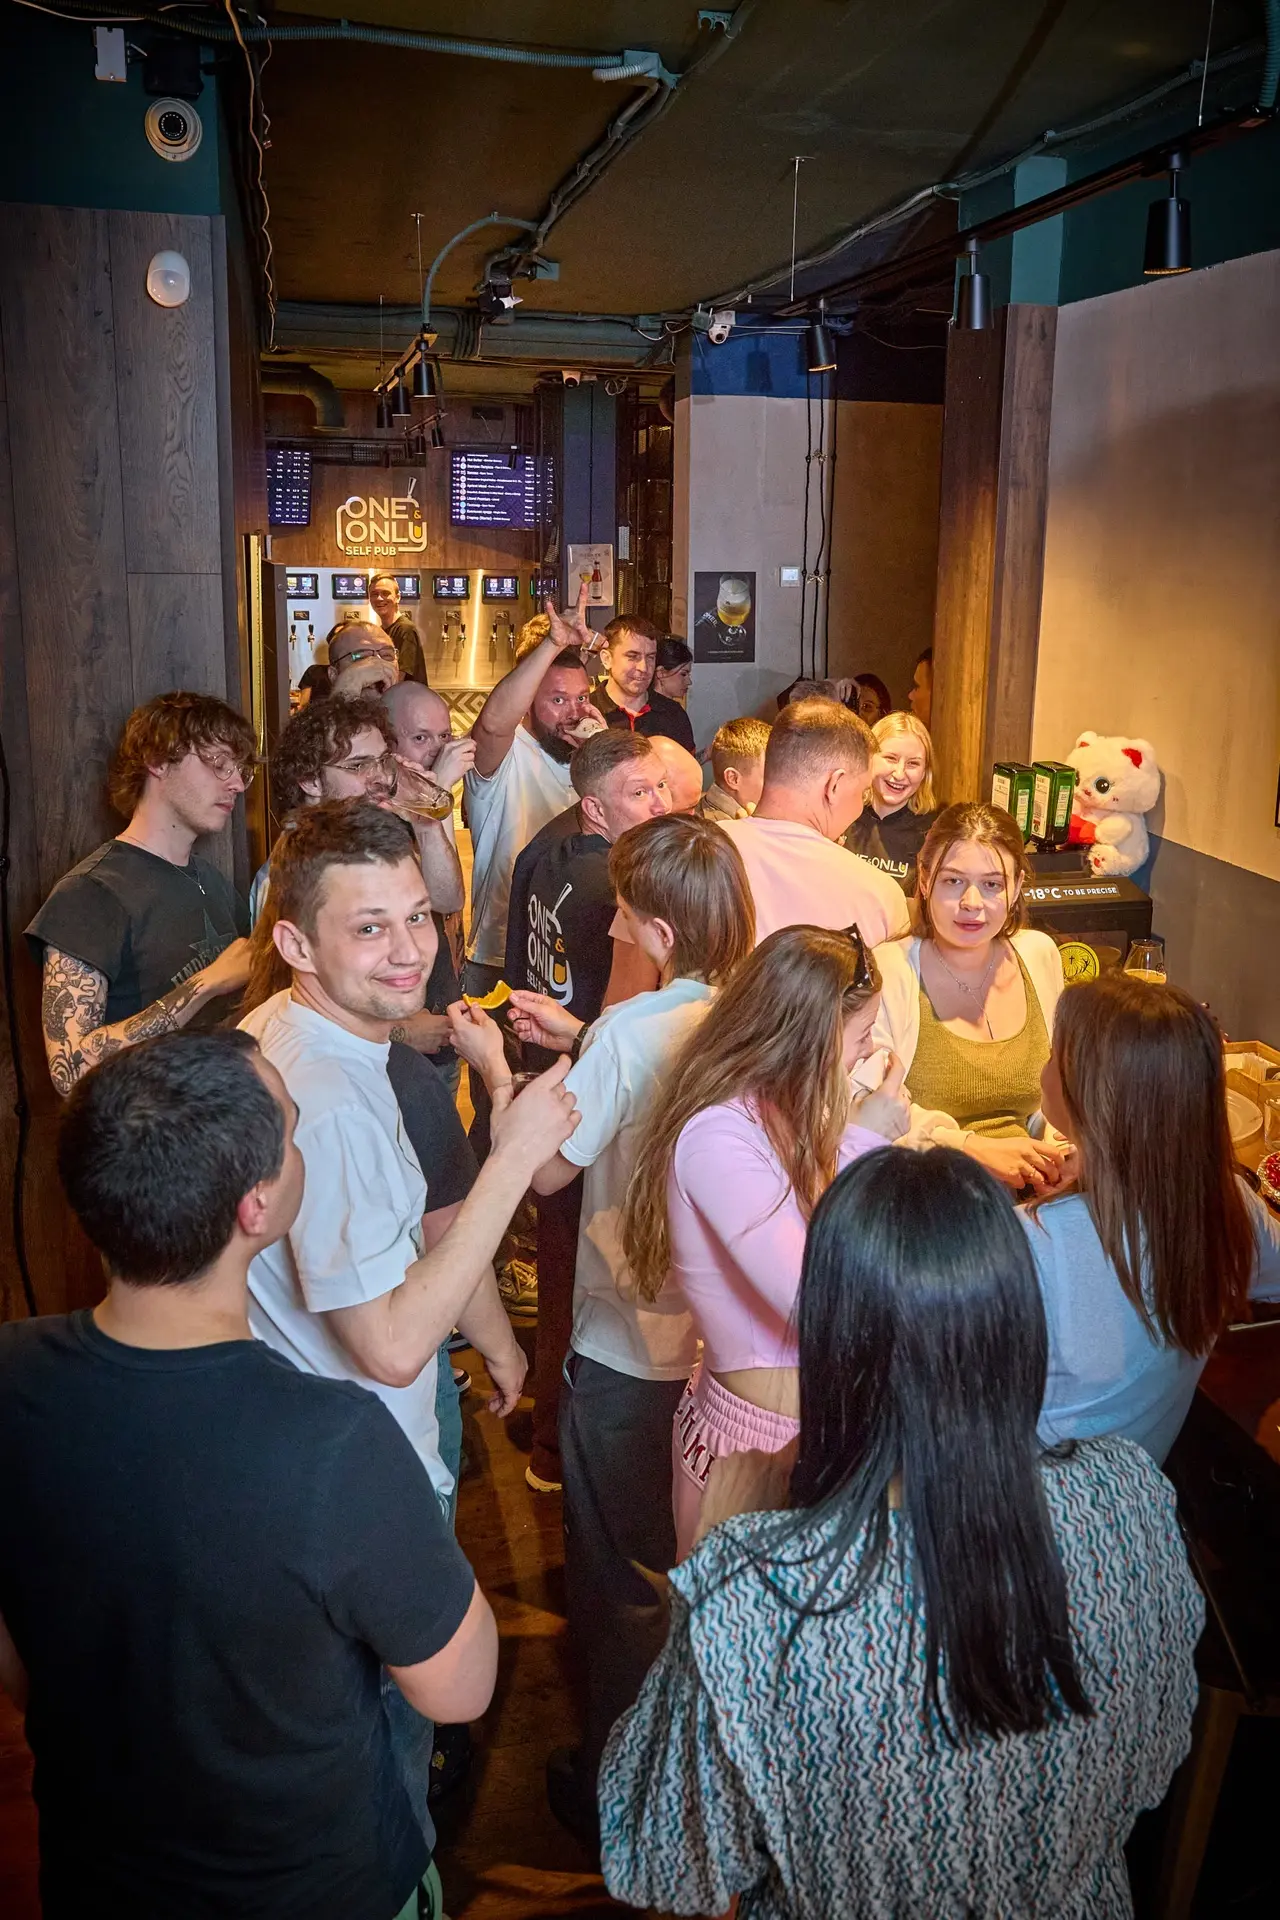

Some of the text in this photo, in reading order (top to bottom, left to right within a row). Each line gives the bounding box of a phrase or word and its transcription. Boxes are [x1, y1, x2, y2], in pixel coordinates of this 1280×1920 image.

[345, 496, 410, 519] ONE
[413, 510, 421, 519] &
[345, 520, 428, 552] ONLY
[345, 546, 397, 556] SELF PUB
[528, 894, 563, 946] ONE
